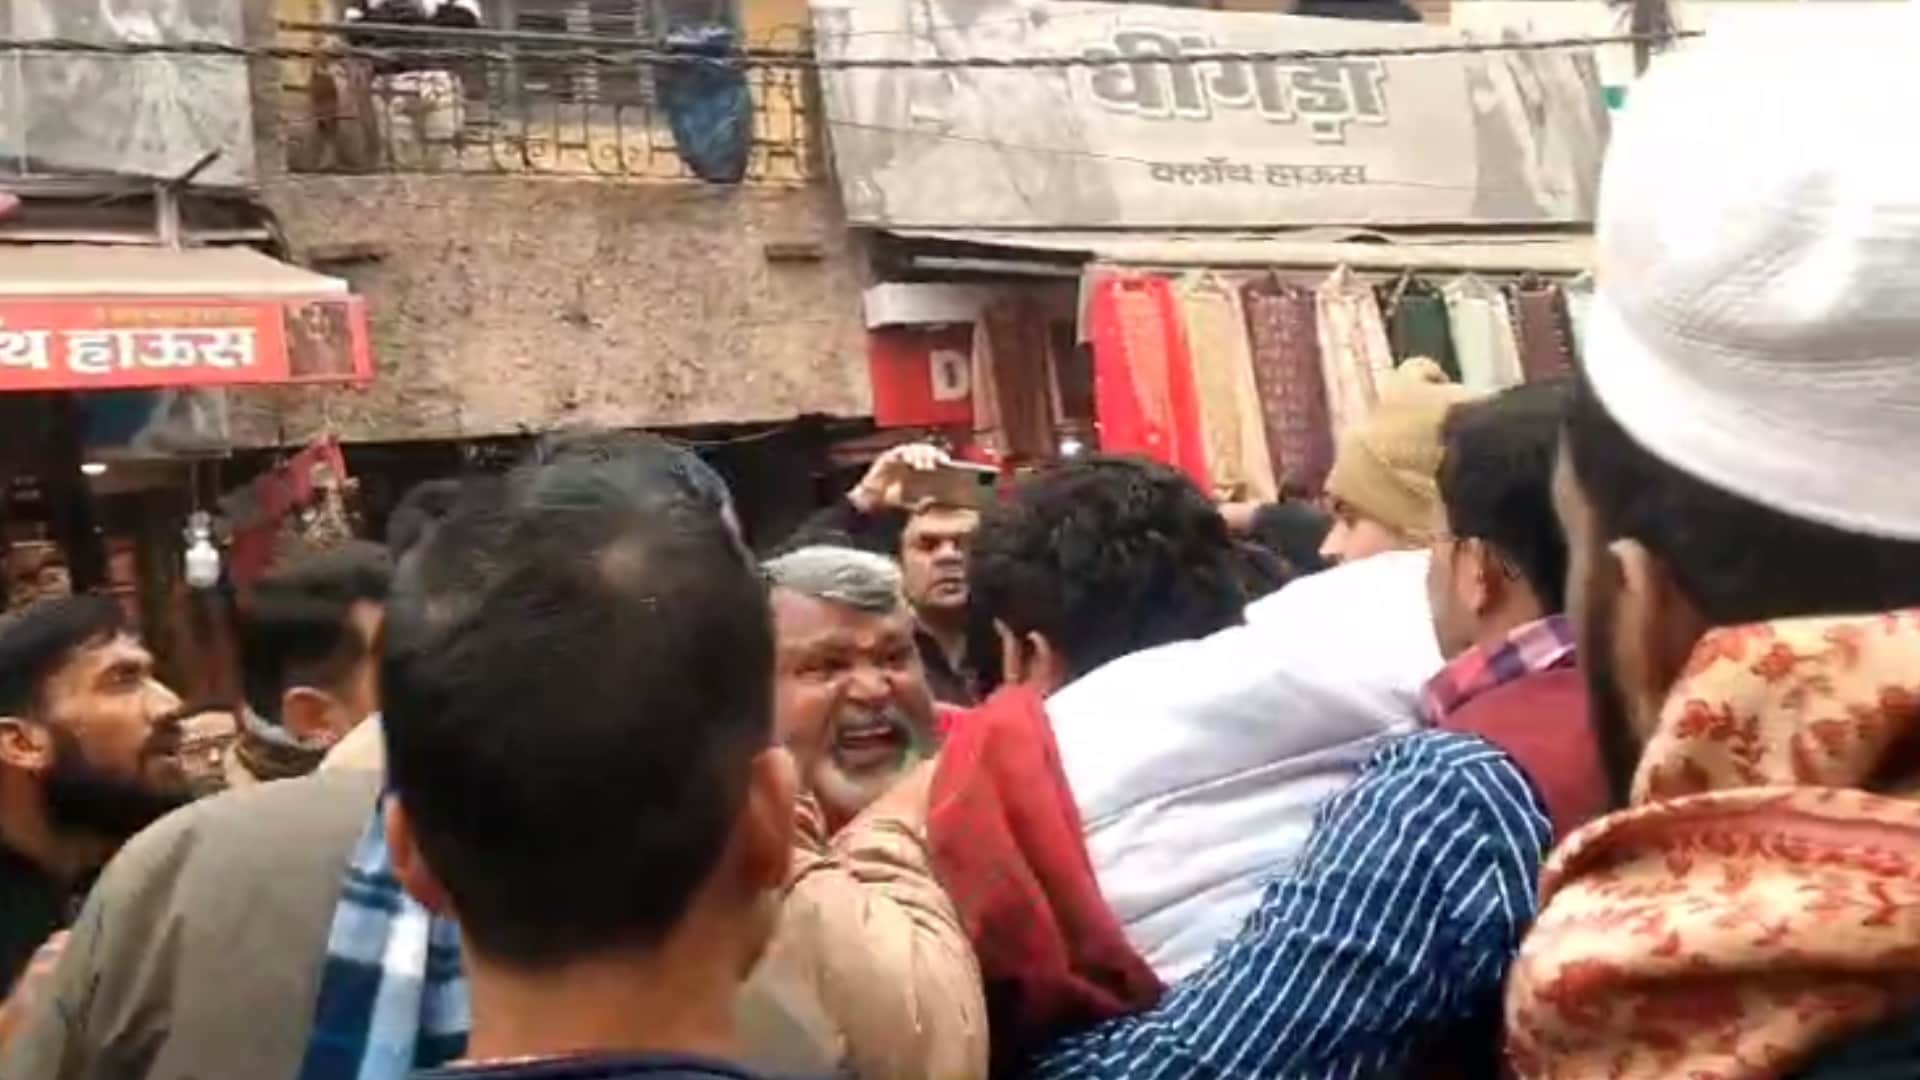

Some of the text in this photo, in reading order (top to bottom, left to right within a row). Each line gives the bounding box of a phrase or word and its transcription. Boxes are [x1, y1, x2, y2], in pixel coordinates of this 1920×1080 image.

[1150, 155, 1367, 187] क्लॉथ हाऊस
[62, 327, 256, 374] हाऊस
